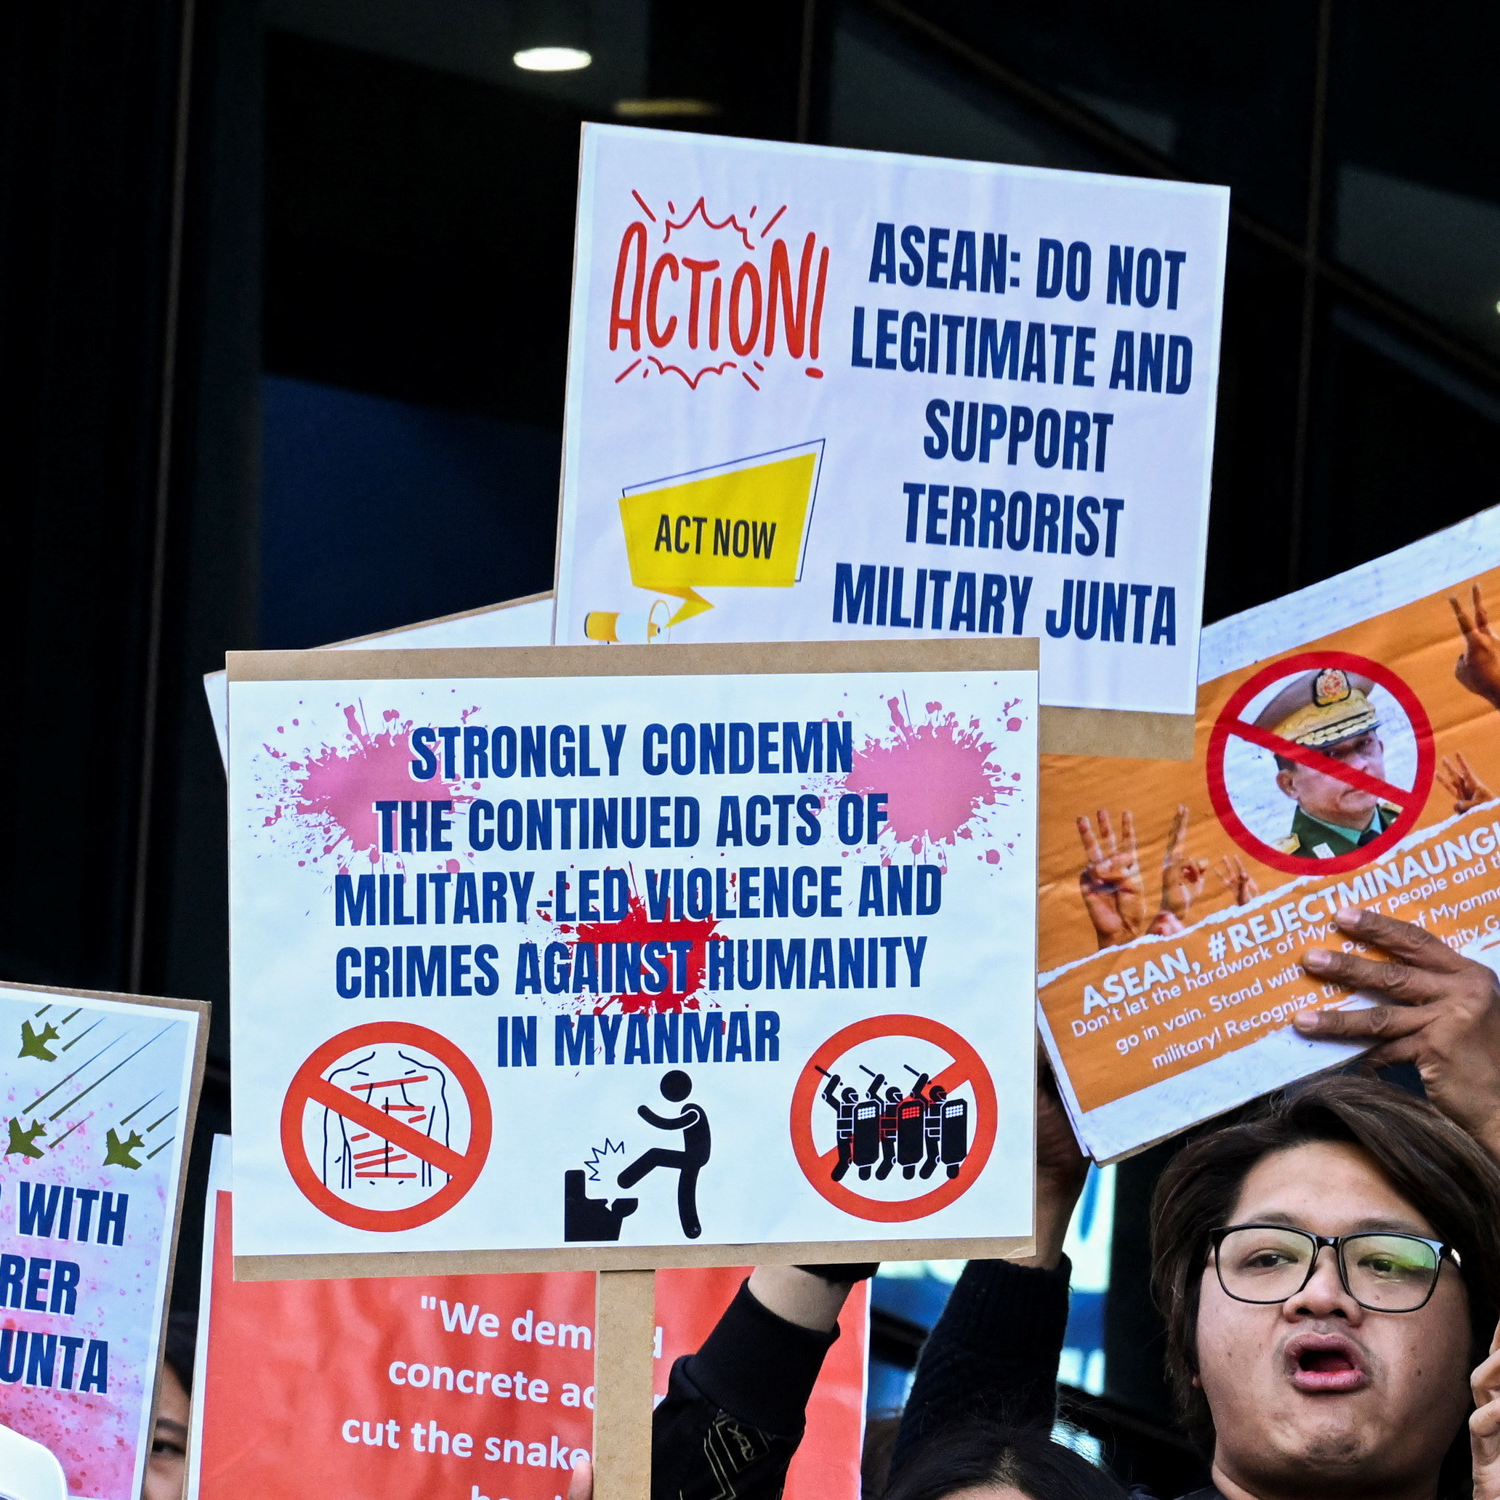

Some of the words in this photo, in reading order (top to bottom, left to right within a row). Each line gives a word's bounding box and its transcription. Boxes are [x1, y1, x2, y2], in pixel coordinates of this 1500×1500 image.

[869, 222, 1021, 294] ASEAN:
[1036, 238, 1091, 301] DO
[1107, 245, 1186, 310] NOT
[609, 221, 830, 379] ACTION!
[852, 307, 1096, 387] LEGITIMATE
[1109, 330, 1192, 394] AND
[924, 399, 1114, 472] SUPPORT
[655, 515, 707, 554] ACT
[714, 519, 776, 558] NOW
[903, 482, 1124, 558] TERRORIST
[833, 563, 1033, 635] MILITARY
[1046, 580, 1175, 646] JUNTA
[412, 725, 626, 779] STRONGLY
[643, 721, 852, 775] CONDEMN
[376, 801, 452, 853] THE
[469, 797, 699, 851] CONTINUED
[716, 794, 821, 846] ACTS
[838, 793, 888, 845] OF
[335, 868, 629, 926] MILITARY-LED
[645, 866, 842, 920] VIOLENCE
[858, 865, 941, 916] AND
[336, 944, 499, 999] CRIMES
[515, 941, 692, 994] AGAINST
[709, 936, 927, 990] HUMANITY
[1071, 1007, 1123, 1038] Don't
[1124, 994, 1148, 1016] let
[1152, 983, 1183, 1008] the
[1185, 943, 1273, 992] hardwork
[1276, 932, 1296, 955] of
[1388, 876, 1448, 913] people
[1452, 861, 1488, 885] and
[1083, 948, 1201, 1015] ASEAN,
[498, 1016, 537, 1067] IN
[555, 1011, 780, 1066] MYANMAR
[1116, 1032, 1141, 1056] go
[1143, 1021, 1161, 1040] in
[1163, 1005, 1207, 1033] vain.
[1209, 981, 1264, 1014] Stand
[1152, 1025, 1223, 1069] military!
[1224, 988, 1319, 1038] Recognize
[20, 1181, 128, 1246] WITH
[420, 1295, 500, 1337] "We
[389, 1361, 549, 1402] concrete
[342, 1419, 400, 1449] cut
[411, 1423, 474, 1456] the
